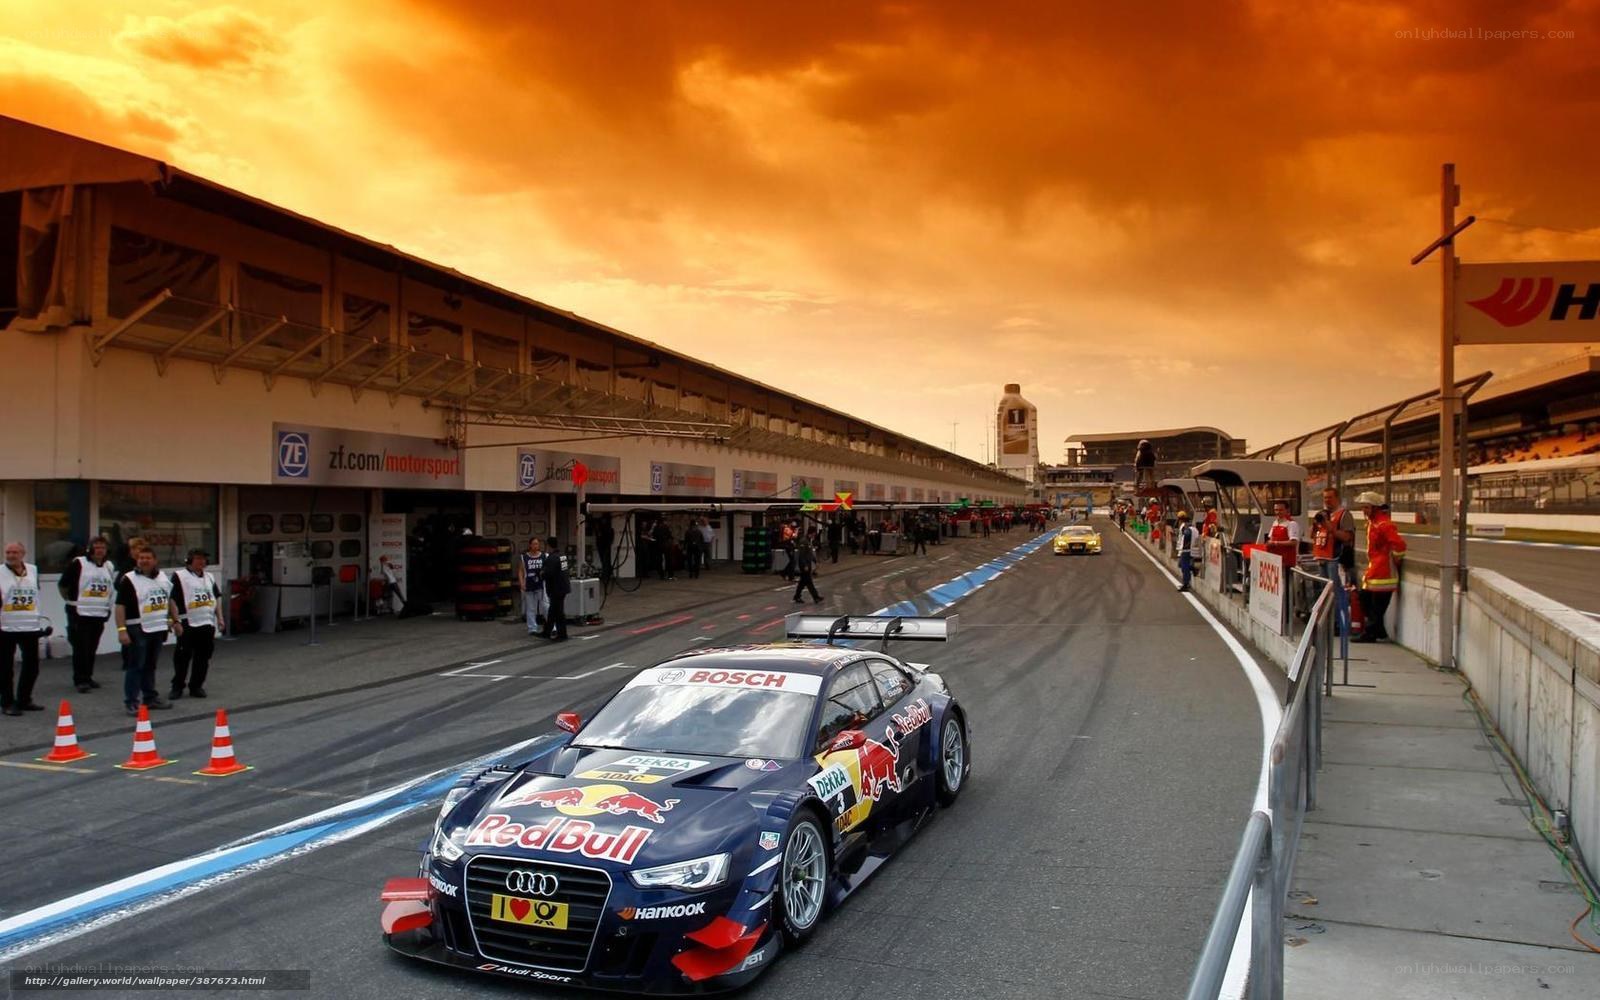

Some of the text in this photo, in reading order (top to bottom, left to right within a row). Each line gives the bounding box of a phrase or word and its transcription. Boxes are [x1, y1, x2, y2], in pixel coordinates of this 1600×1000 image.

[1548, 283, 1600, 321] H
[329, 445, 460, 480] zf.com/motorsport
[1259, 561, 1279, 596] BOSCH
[688, 671, 787, 688] BOSCH
[628, 757, 691, 769] DEKRA
[597, 772, 645, 782] ADAC
[816, 768, 847, 798] DEKRA
[837, 792, 846, 814] 3
[740, 950, 765, 971] ABT
[498, 965, 572, 983] Audi Sport
